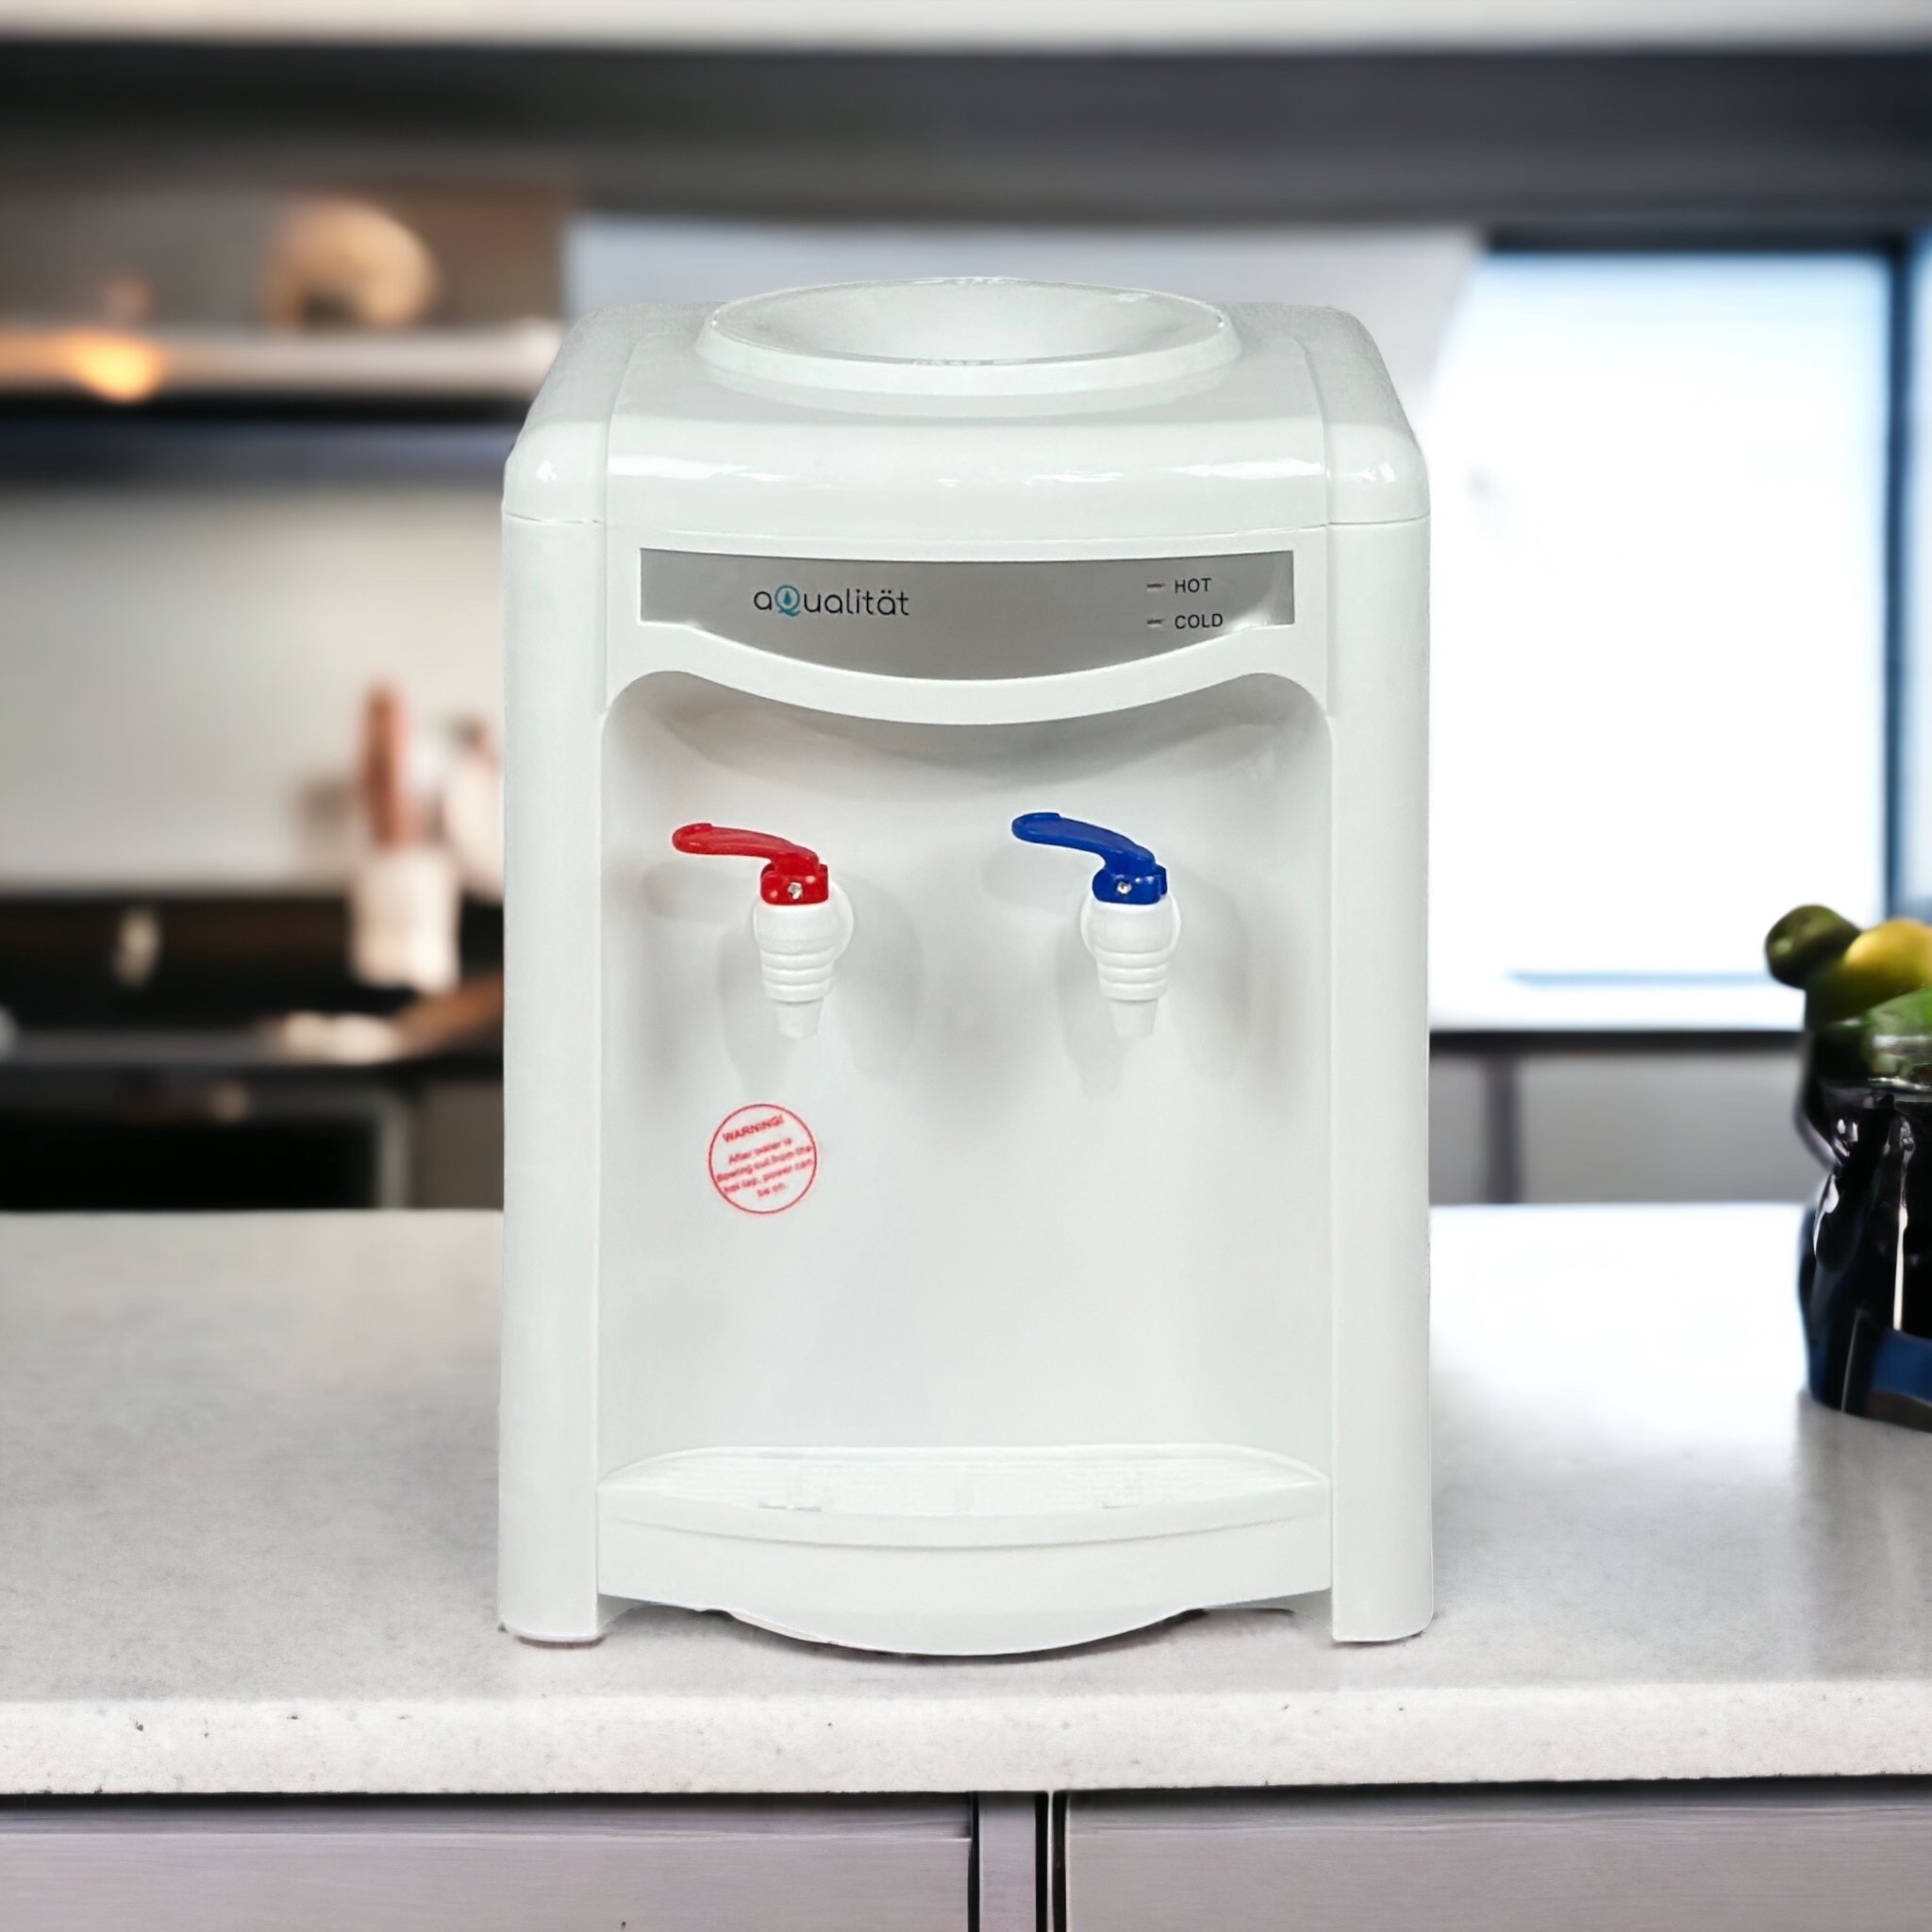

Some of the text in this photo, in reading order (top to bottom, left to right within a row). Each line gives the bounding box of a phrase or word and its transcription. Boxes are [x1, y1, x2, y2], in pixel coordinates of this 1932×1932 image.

[1174, 577, 1212, 593] HOT
[753, 585, 909, 617] aQualität
[1174, 613, 1224, 629] COLD
[723, 1115, 784, 1142] WARNING!
